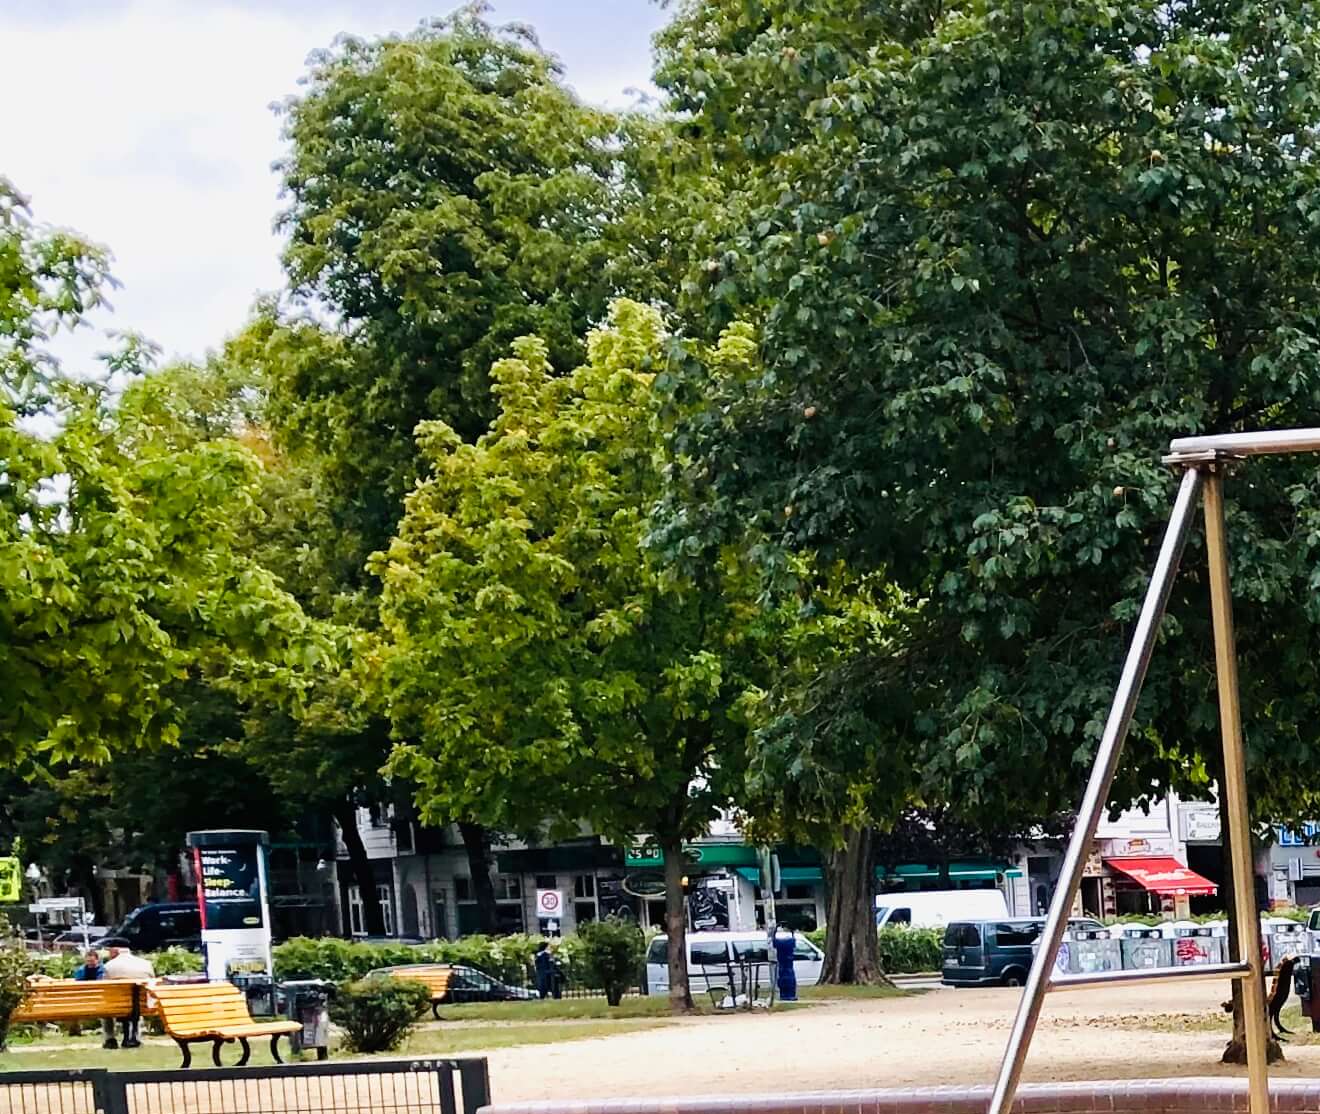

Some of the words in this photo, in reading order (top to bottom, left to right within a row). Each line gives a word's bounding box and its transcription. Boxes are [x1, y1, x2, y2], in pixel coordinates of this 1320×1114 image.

[201, 855, 232, 864] Work-
[203, 866, 225, 876] Life-
[204, 878, 235, 888] Sleep-
